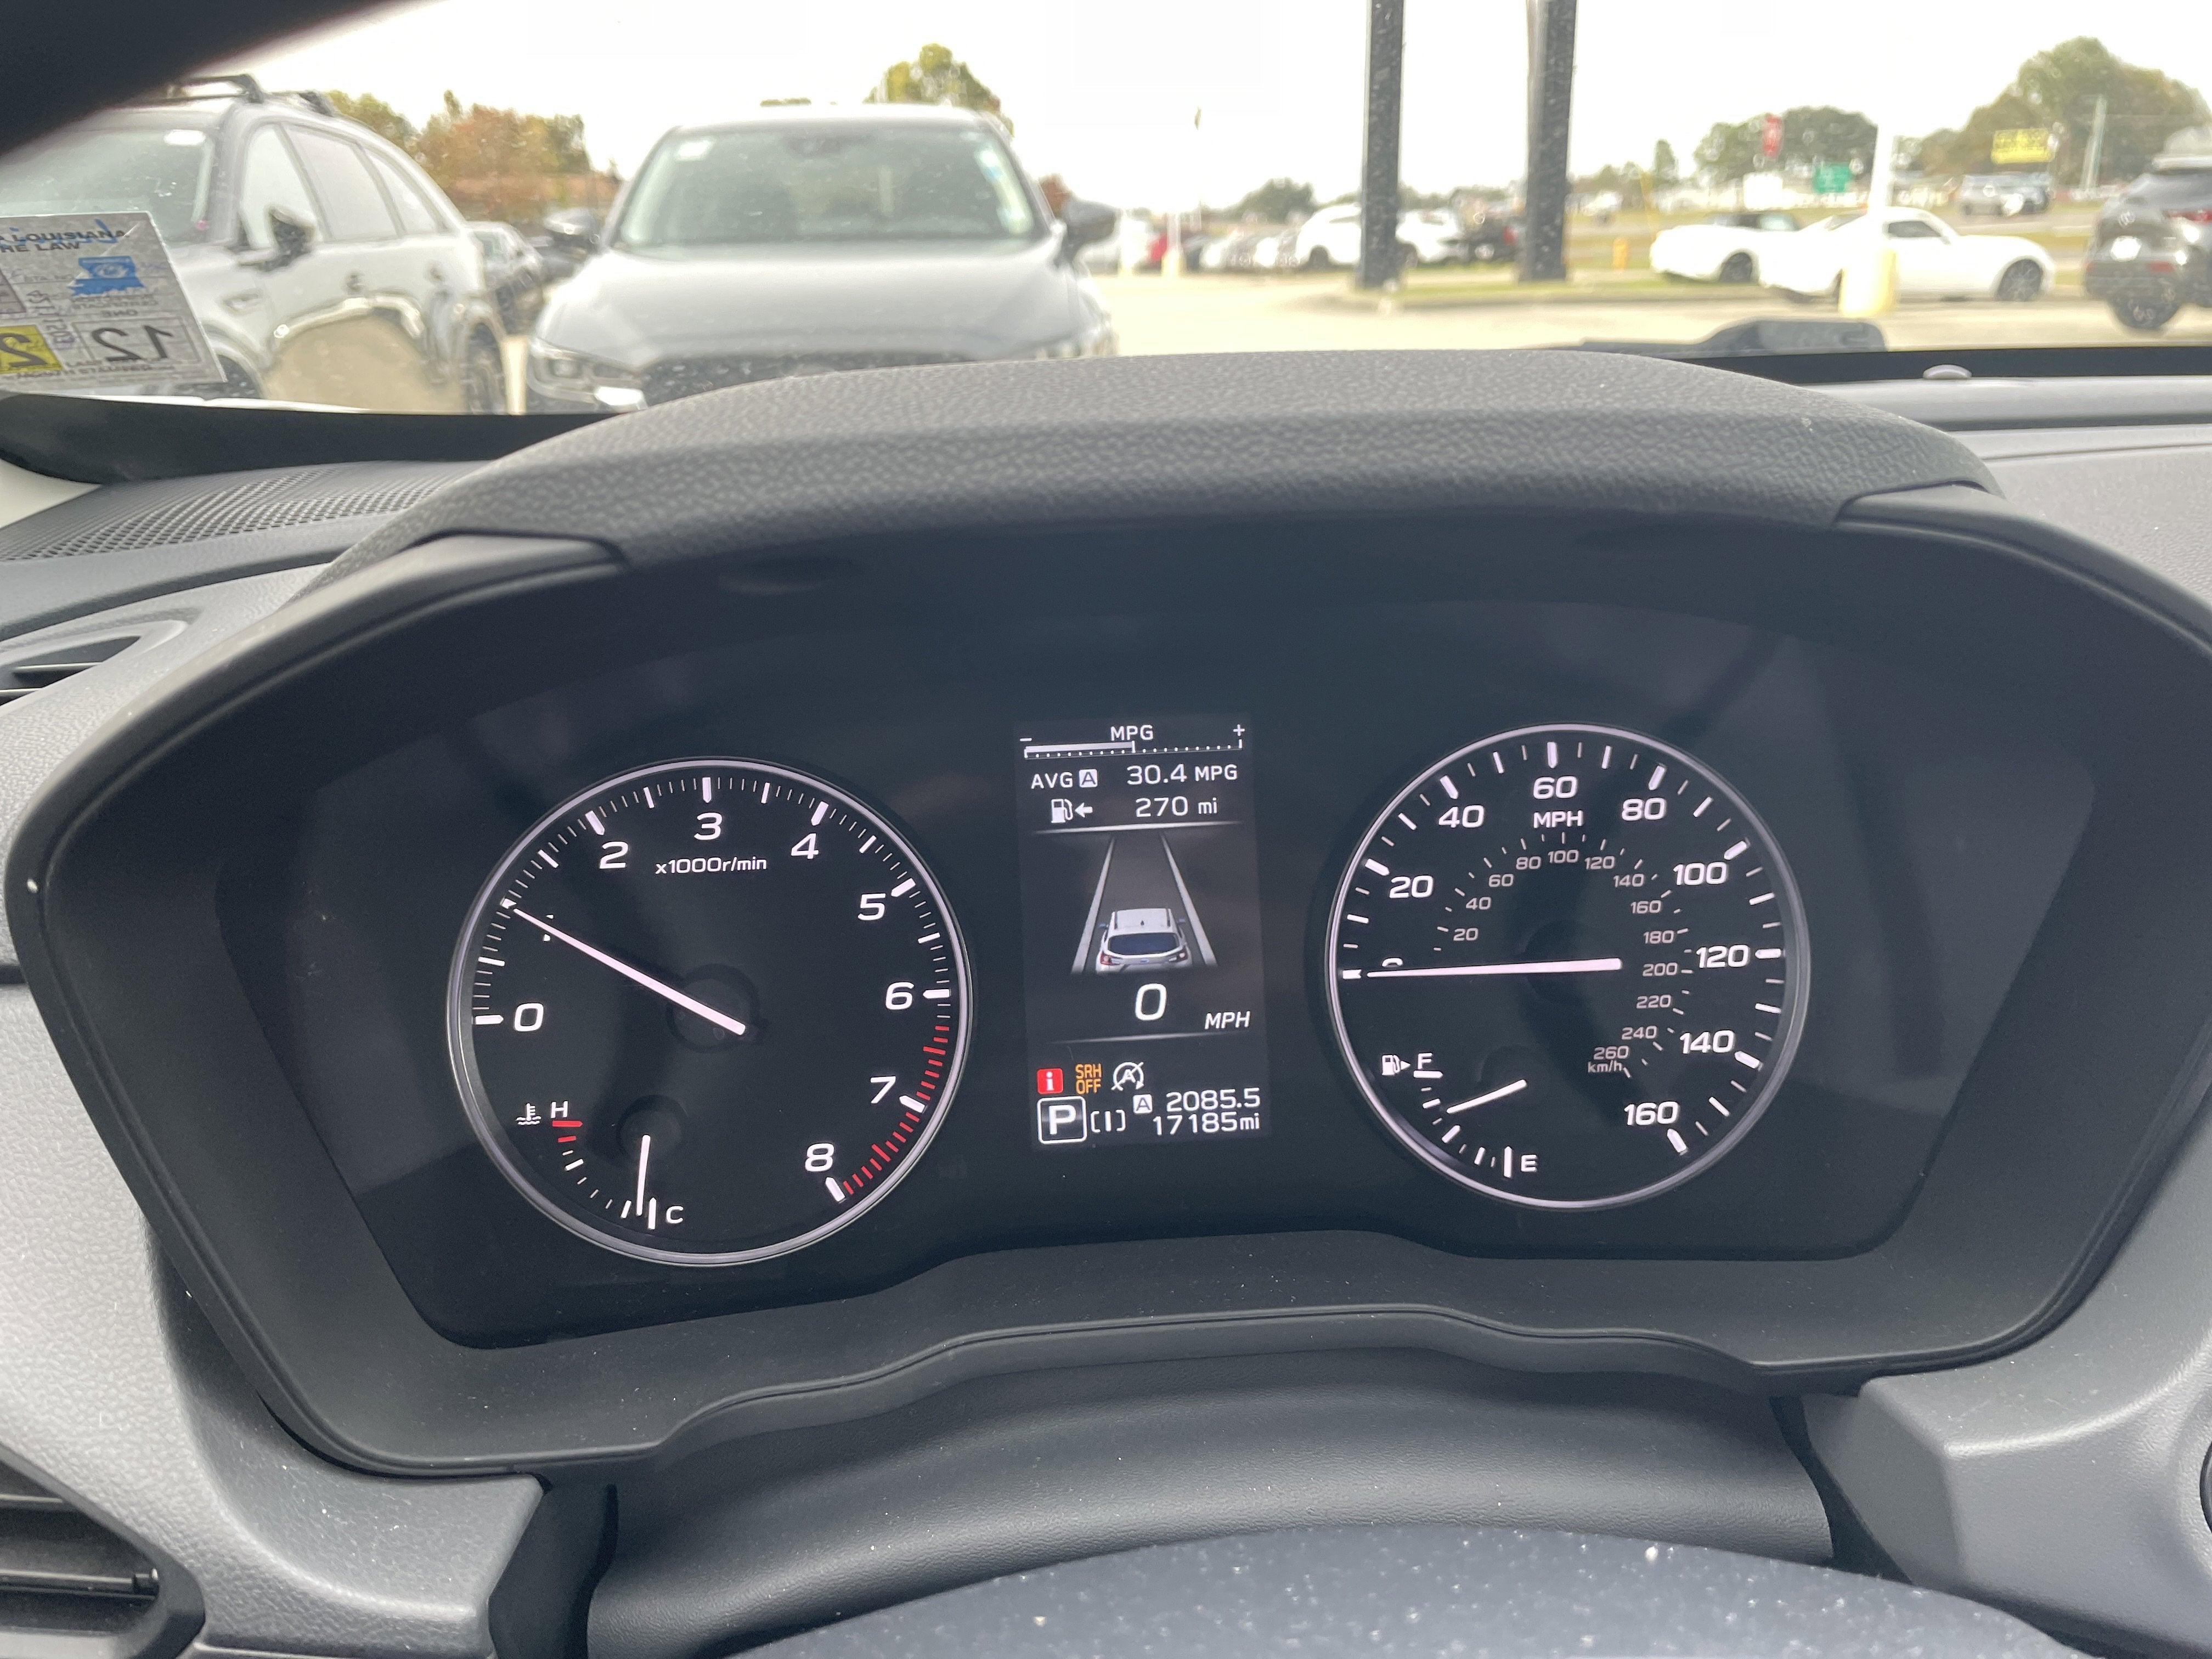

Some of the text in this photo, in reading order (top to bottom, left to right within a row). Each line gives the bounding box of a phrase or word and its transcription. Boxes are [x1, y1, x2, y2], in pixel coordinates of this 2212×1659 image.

[34, 241, 80, 251] LAW
[1110, 725, 1154, 741] MPG
[1031, 772, 1073, 789] AVG
[1127, 764, 1187, 785] 30.4
[1195, 764, 1237, 782] MPG
[1533, 776, 1578, 799] 60
[1135, 795, 1217, 817] 270 mi
[1621, 797, 1667, 821] 80
[693, 812, 723, 840] 3
[1438, 805, 1485, 828] 40
[1533, 810, 1583, 829] MPH
[599, 841, 629, 869] 2
[1515, 856, 1542, 870] 80
[1548, 849, 1579, 864] 100
[1584, 856, 1615, 870] 120
[655, 856, 767, 874] x1000r/min
[1673, 861, 1727, 885] 100
[1389, 874, 1434, 899] 20
[1488, 873, 1514, 888] 60
[1613, 873, 1644, 888] 140
[857, 893, 886, 921] 5
[1465, 896, 1491, 910] 40
[1630, 900, 1662, 914] 160
[1453, 928, 1479, 941] 20
[1644, 930, 1674, 944] 180
[1696, 944, 1751, 968] 120
[1643, 962, 1678, 977] 200
[885, 981, 915, 1010] 6
[1135, 983, 1167, 1021] 0
[1636, 994, 1672, 1009] 220
[514, 1003, 544, 1032] 0
[1204, 1011, 1250, 1030] MPH
[1621, 1025, 1657, 1040] 240
[1679, 1030, 1735, 1054] 140
[1417, 1052, 1432, 1070] F
[1593, 1045, 1629, 1060] 260
[1075, 1063, 1102, 1080] SRH
[1588, 1059, 1622, 1073] km/h
[870, 1076, 896, 1104] 7
[1076, 1079, 1102, 1094] OFF
[1166, 1087, 1260, 1113] 2085.5
[550, 1101, 568, 1119] H
[1624, 1101, 1679, 1126] 160
[1047, 1104, 1077, 1136] P
[805, 1143, 834, 1172] 8
[1521, 1154, 1537, 1172] E
[666, 1205, 684, 1224] C
